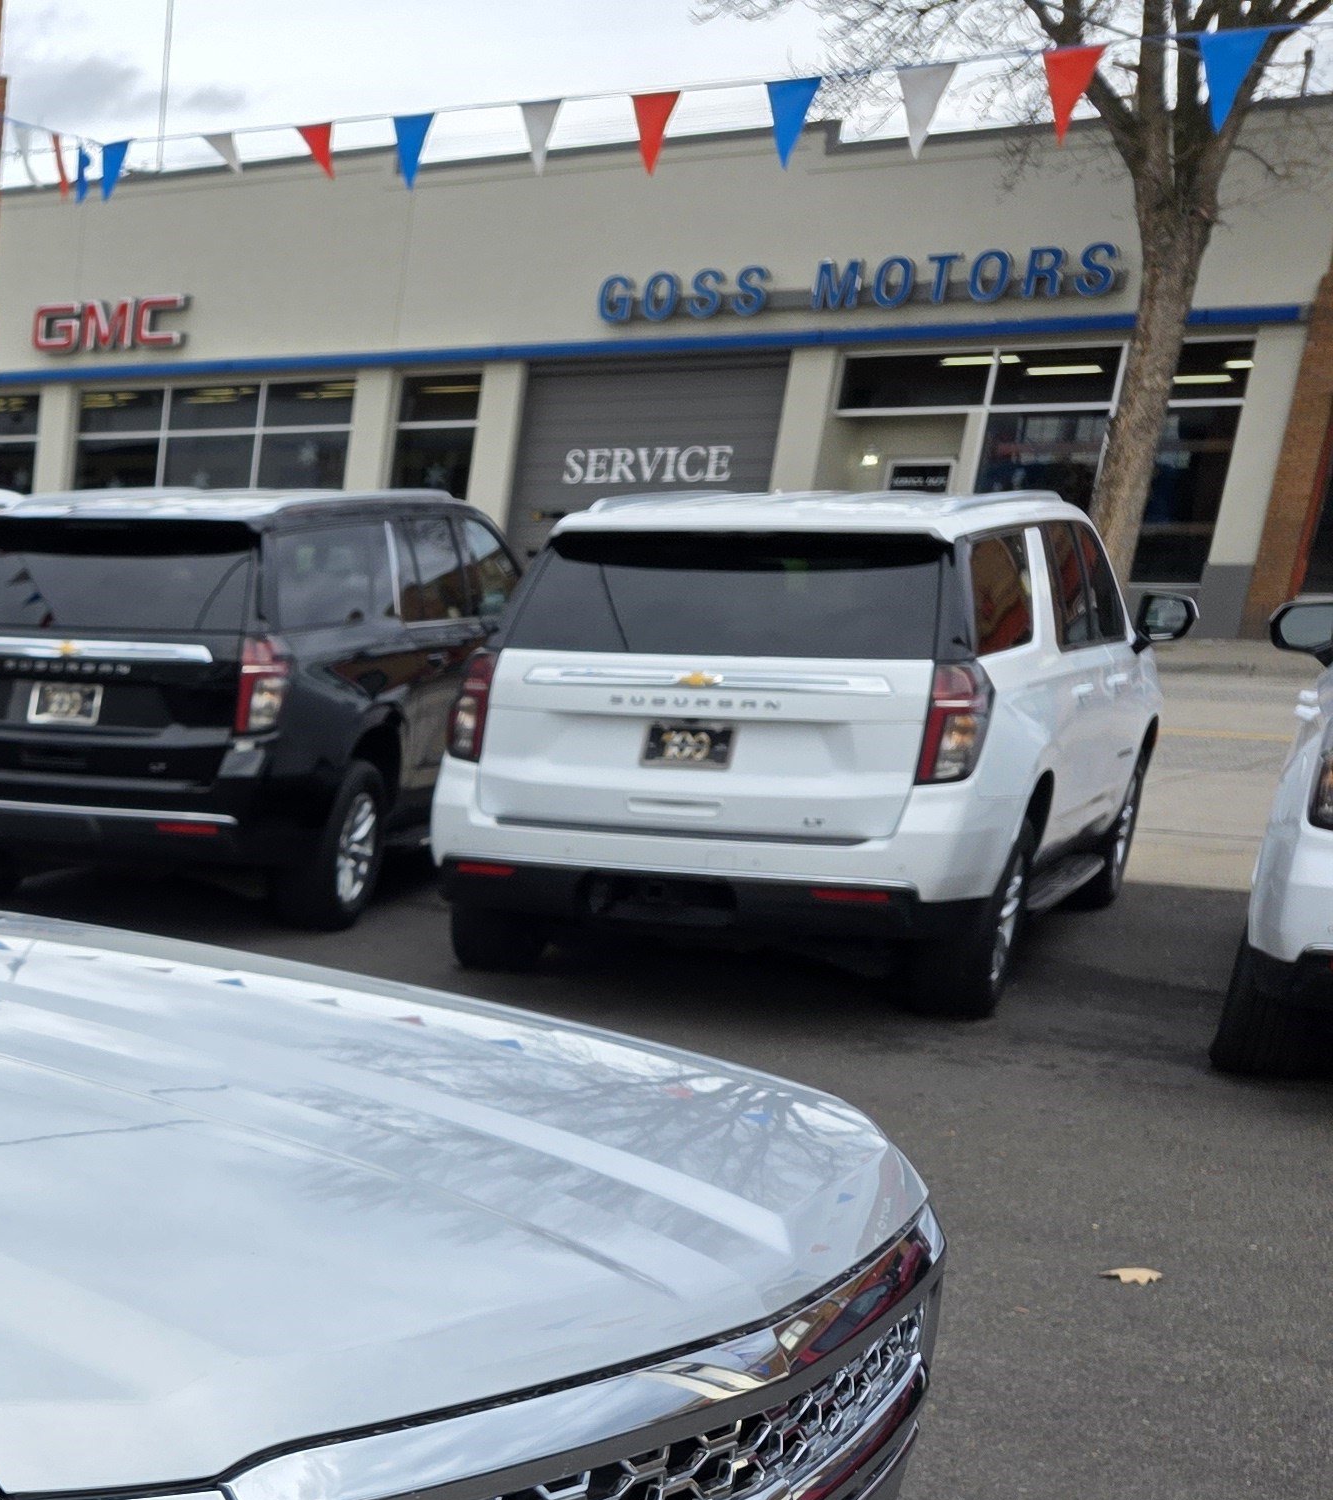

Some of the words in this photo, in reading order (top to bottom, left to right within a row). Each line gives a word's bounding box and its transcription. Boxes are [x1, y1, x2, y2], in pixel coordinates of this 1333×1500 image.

[597, 265, 771, 324] GOSS
[811, 241, 1120, 312] MOTORS
[30, 293, 186, 352] GMC
[562, 445, 734, 485] SERVICE
[610, 694, 781, 710] SUBURBAN
